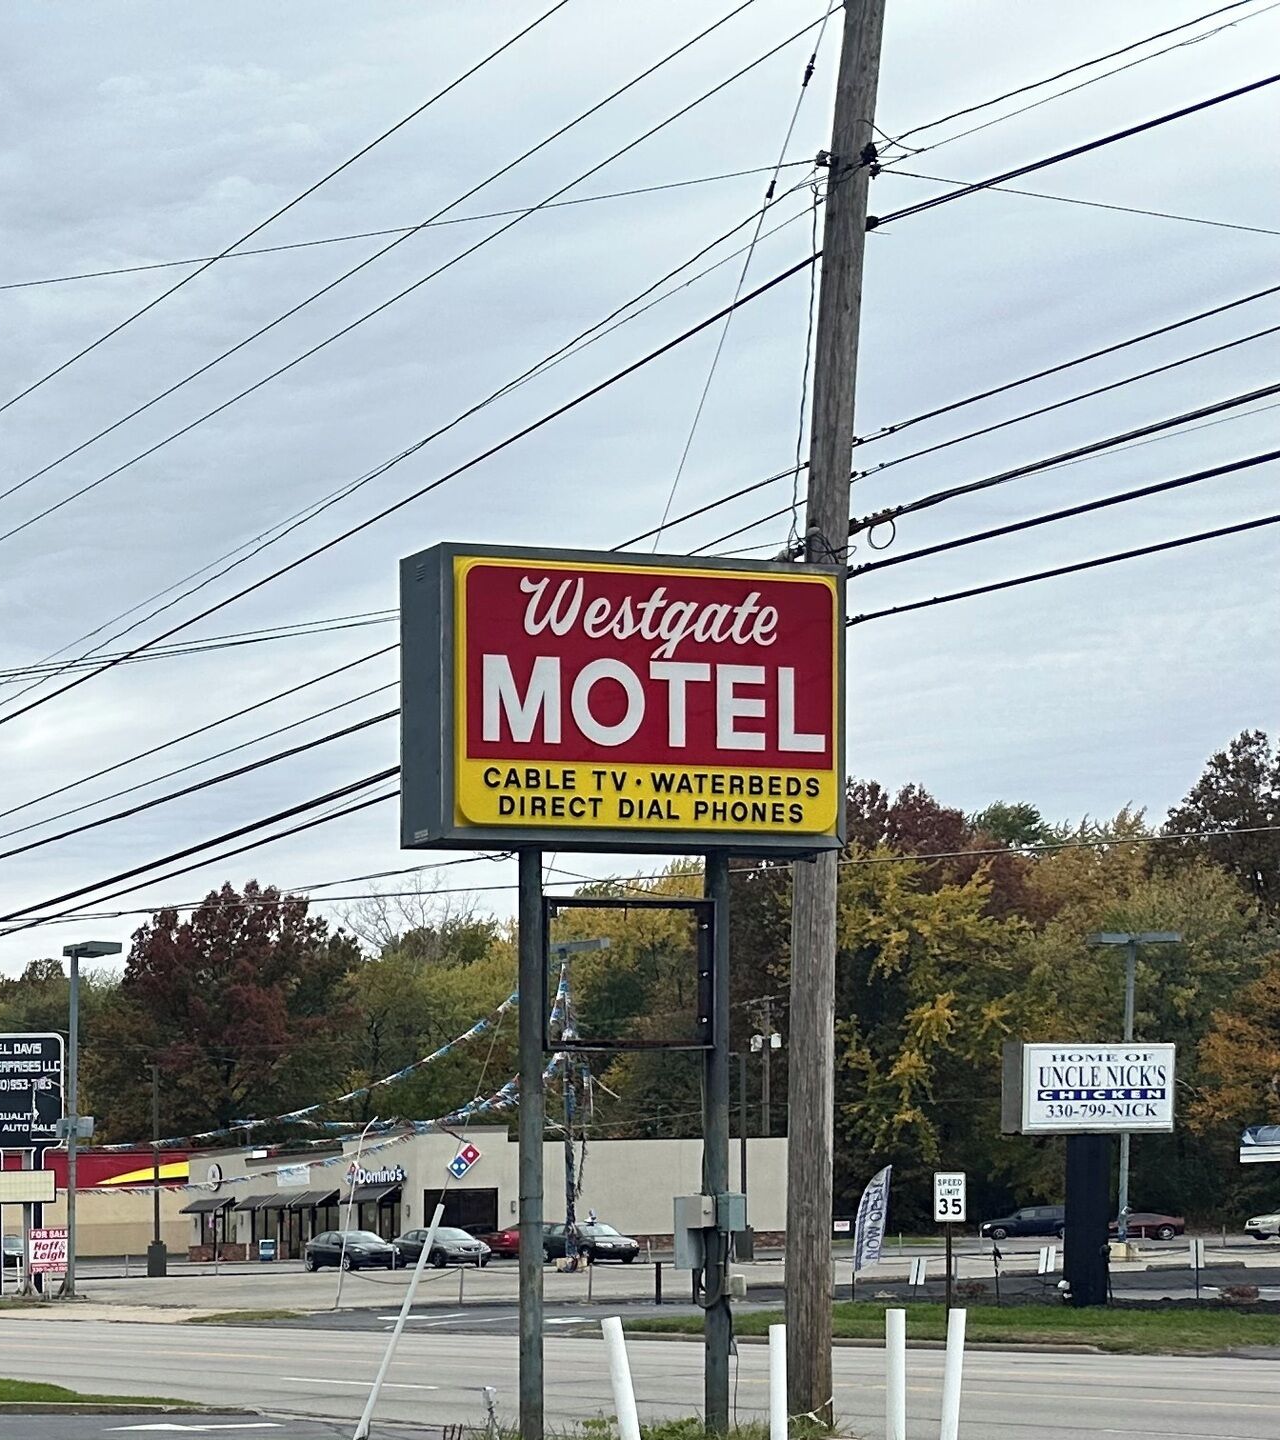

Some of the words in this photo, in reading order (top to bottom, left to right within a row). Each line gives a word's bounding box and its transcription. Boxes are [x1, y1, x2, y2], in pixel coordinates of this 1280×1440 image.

[519, 575, 779, 659] Westgate
[482, 653, 827, 753] MOTEL
[483, 766, 577, 791] CABLE
[592, 771, 628, 792] TV
[651, 772, 821, 797] WATERBEDS
[498, 795, 604, 818] DIRECT
[618, 799, 680, 820] DIAL
[694, 802, 804, 823] PHONES
[13, 1043, 42, 1055] DAVIS
[1052, 1053, 1119, 1063] HOME
[1125, 1053, 1154, 1062] OF
[42, 1060, 61, 1072] LLC
[1038, 1066, 1102, 1088] UNCLE
[1106, 1064, 1167, 1087] NICK'S
[1039, 1090, 1162, 1100] CHICKEN
[1045, 1103, 1158, 1118] 330-799-NICK
[1, 1124, 30, 1132] AUTO
[30, 1124, 57, 1132] SALE
[358, 1164, 403, 1184] Domino's
[937, 1178, 963, 1187] SPEED
[939, 1188, 960, 1196] LIMIT
[937, 1198, 963, 1215] 35
[30, 1230, 48, 1239] FOR
[864, 1226, 882, 1260] NOW
[33, 1250, 65, 1261] Leigh
